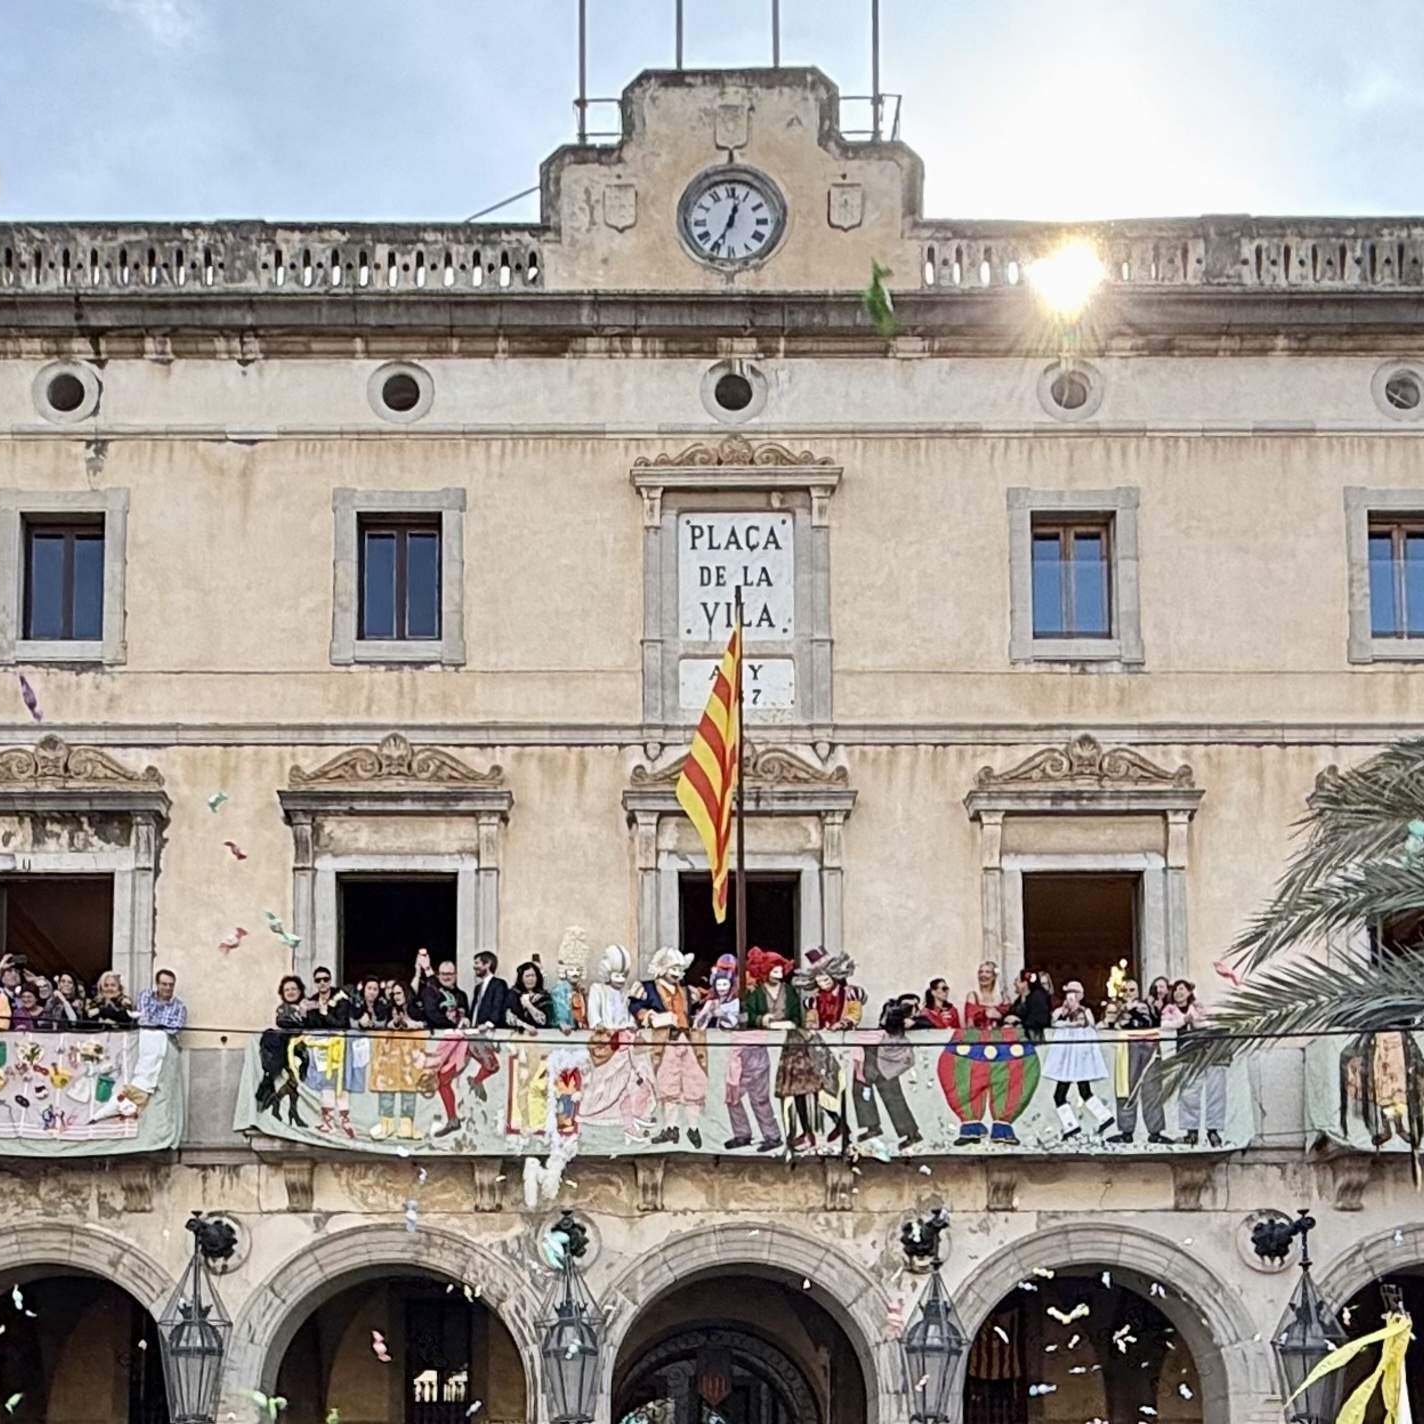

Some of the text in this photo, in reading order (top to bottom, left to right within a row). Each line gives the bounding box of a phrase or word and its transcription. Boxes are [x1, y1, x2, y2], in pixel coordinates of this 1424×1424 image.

[689, 524, 782, 551] PLAÇA
[699, 566, 773, 587] DE LA
[700, 602, 776, 628] VILA
